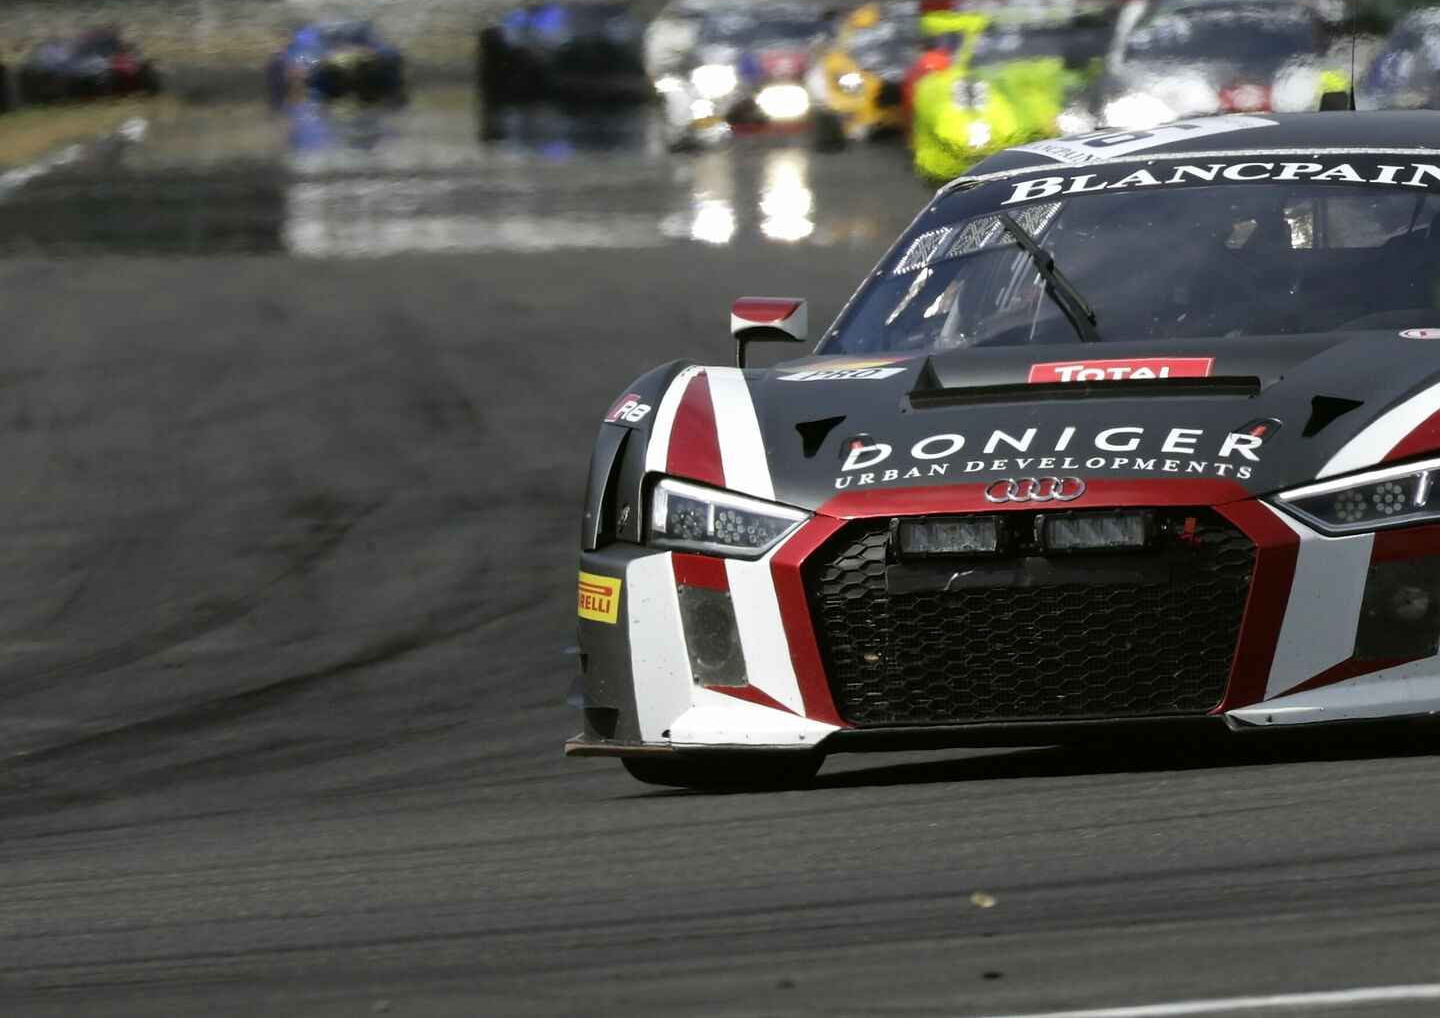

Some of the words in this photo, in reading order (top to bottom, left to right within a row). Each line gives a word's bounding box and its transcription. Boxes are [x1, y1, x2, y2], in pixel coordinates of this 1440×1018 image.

[611, 398, 651, 422] R8
[841, 426, 1263, 472] DONIGER
[834, 463, 950, 489] URBAN
[963, 457, 1252, 480] DEVELOPMENTS
[579, 582, 612, 613] RELLI
